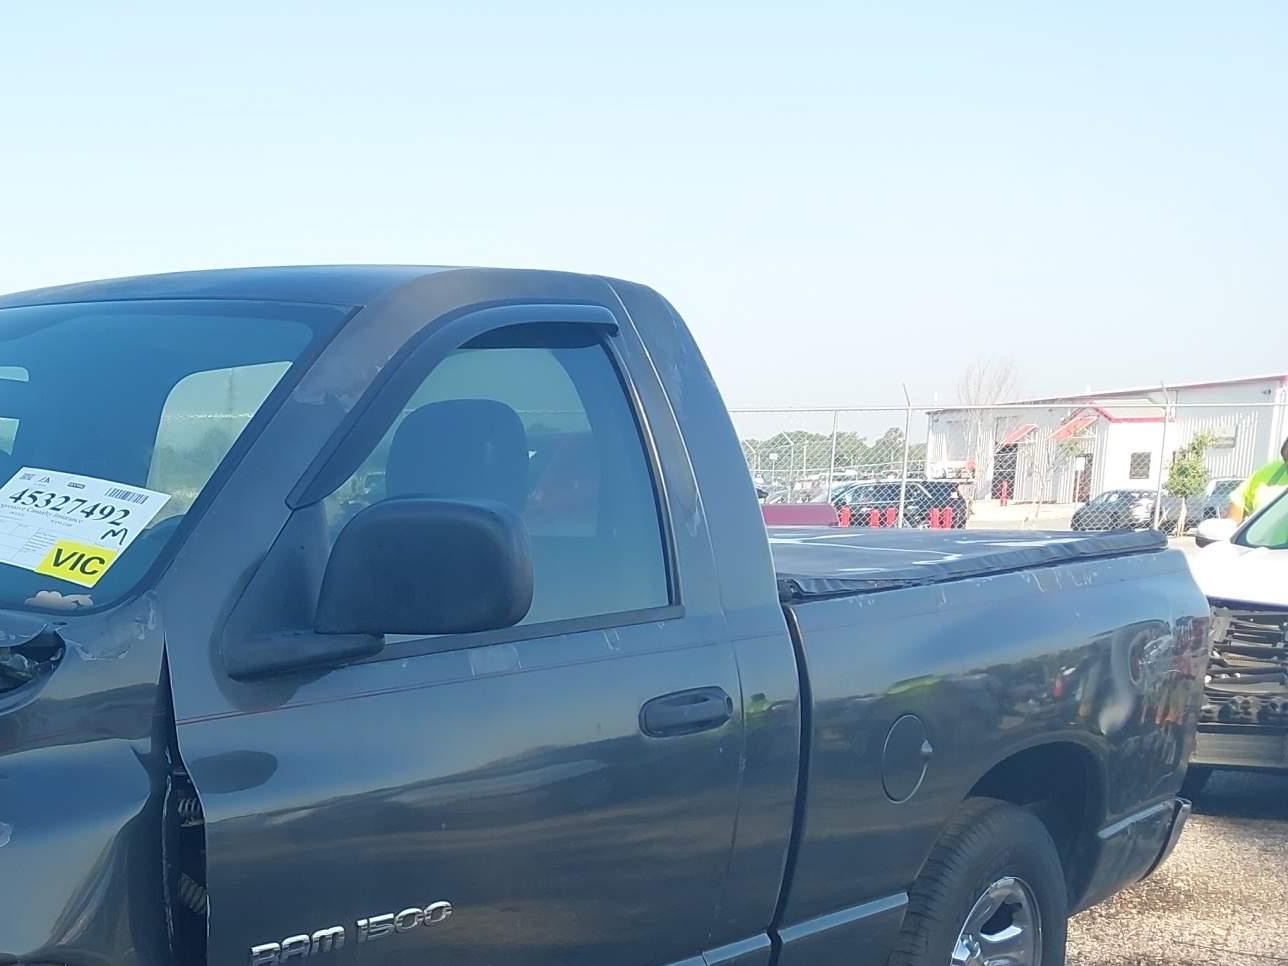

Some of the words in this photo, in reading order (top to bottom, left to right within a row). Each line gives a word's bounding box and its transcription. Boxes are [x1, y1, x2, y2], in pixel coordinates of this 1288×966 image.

[9, 488, 131, 526] 45327492
[100, 527, 128, 546] M
[51, 547, 106, 576] VIC
[355, 899, 454, 944] 1500
